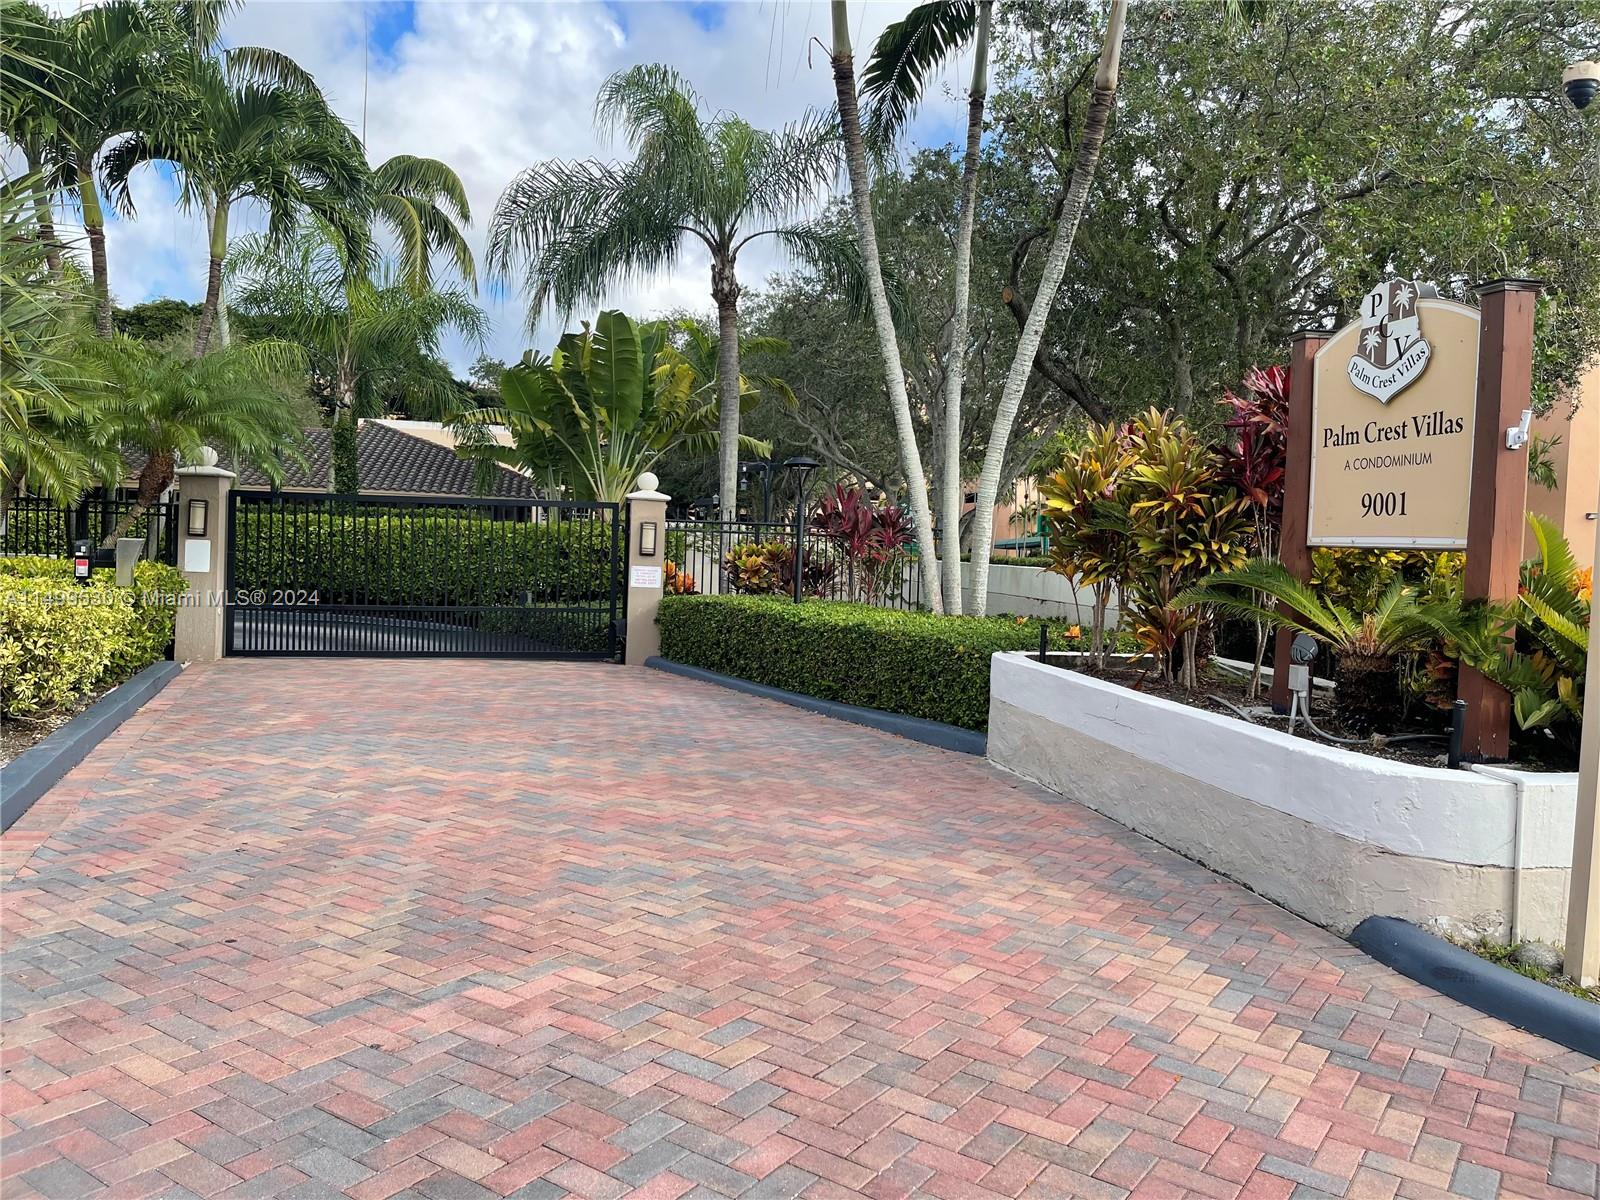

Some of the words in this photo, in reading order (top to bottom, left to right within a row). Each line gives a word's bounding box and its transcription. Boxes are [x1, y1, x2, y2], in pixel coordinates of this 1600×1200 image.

[1369, 292, 1383, 318] P
[1379, 312, 1394, 339] C
[1393, 334, 1411, 361] V
[1350, 361, 1371, 386] Palm
[1371, 373, 1397, 389] Crest
[1396, 347, 1426, 377] Villas
[1322, 424, 1361, 448] Palm
[1364, 420, 1408, 444] Crest
[1411, 410, 1465, 438] Villas
[1343, 459, 1351, 471] A
[1353, 452, 1433, 471] CONDOMINIUM
[1361, 491, 1408, 519] 9001
